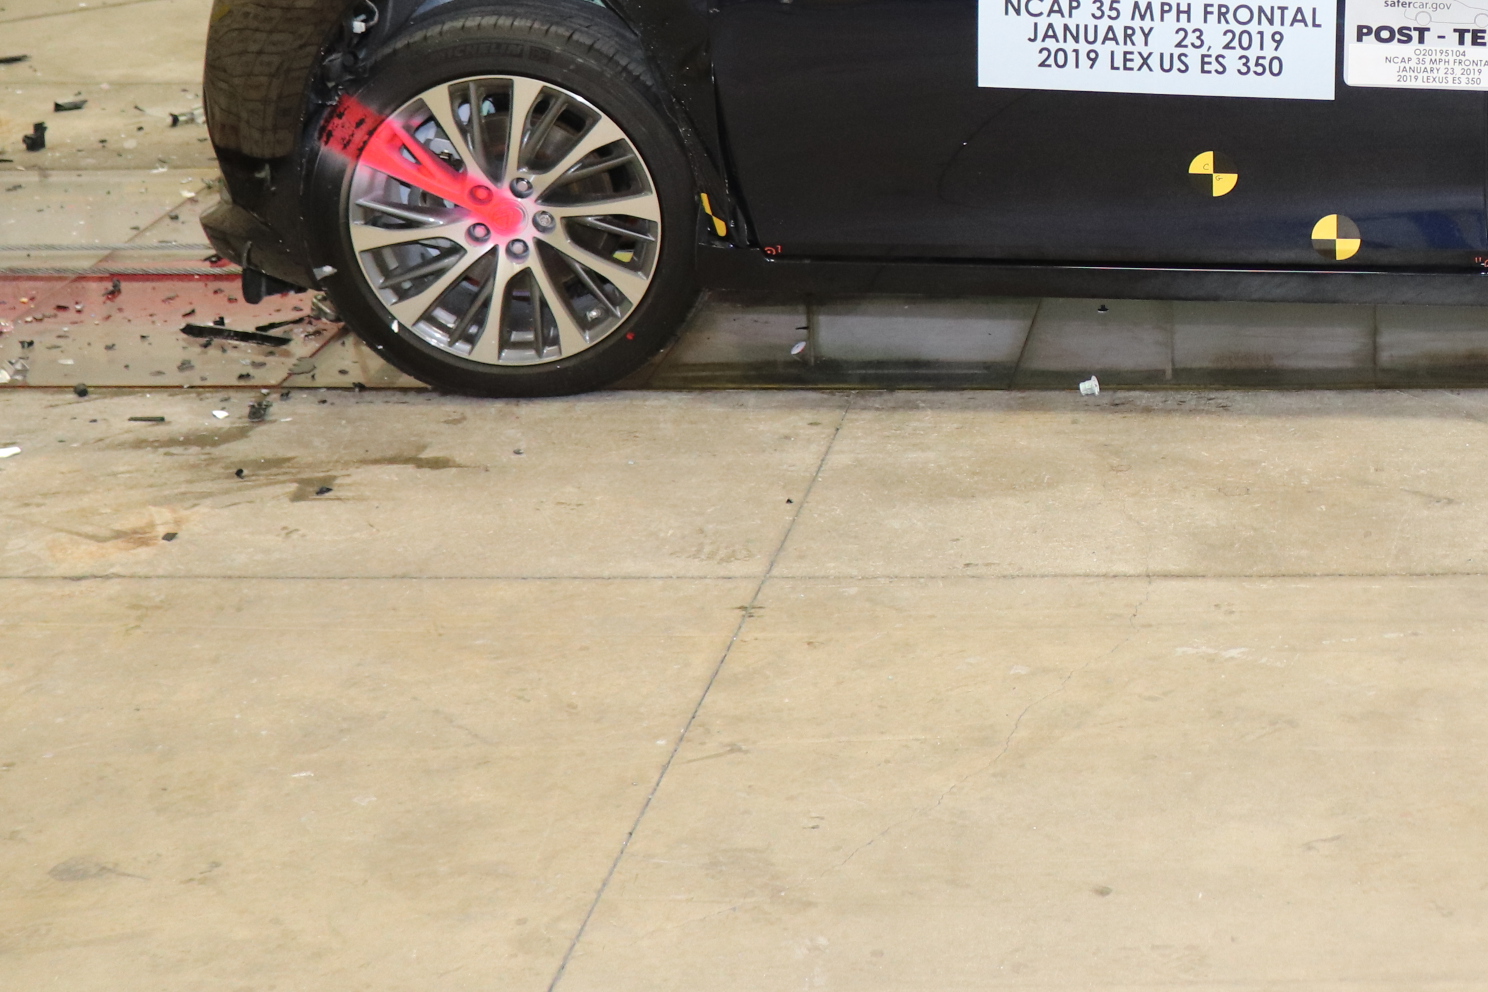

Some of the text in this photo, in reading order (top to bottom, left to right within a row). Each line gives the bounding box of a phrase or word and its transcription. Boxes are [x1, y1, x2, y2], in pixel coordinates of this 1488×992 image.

[1091, 0, 1121, 21] 35
[1130, 1, 1192, 24] MPH
[1203, 4, 1322, 28] FRONTAL
[1027, 22, 1284, 53] JANUARY 23, 2019
[1356, 24, 1431, 45] POST
[1037, 48, 1284, 78] 2019 LEXUS ES 350
[1385, 56, 1412, 65] NCAP
[1415, 57, 1426, 65] 35
[1429, 58, 1450, 67] MPH
[1396, 66, 1482, 76] JANUARY 23, 2019
[1397, 75, 1482, 85] 2019 LEXUS ES 350
